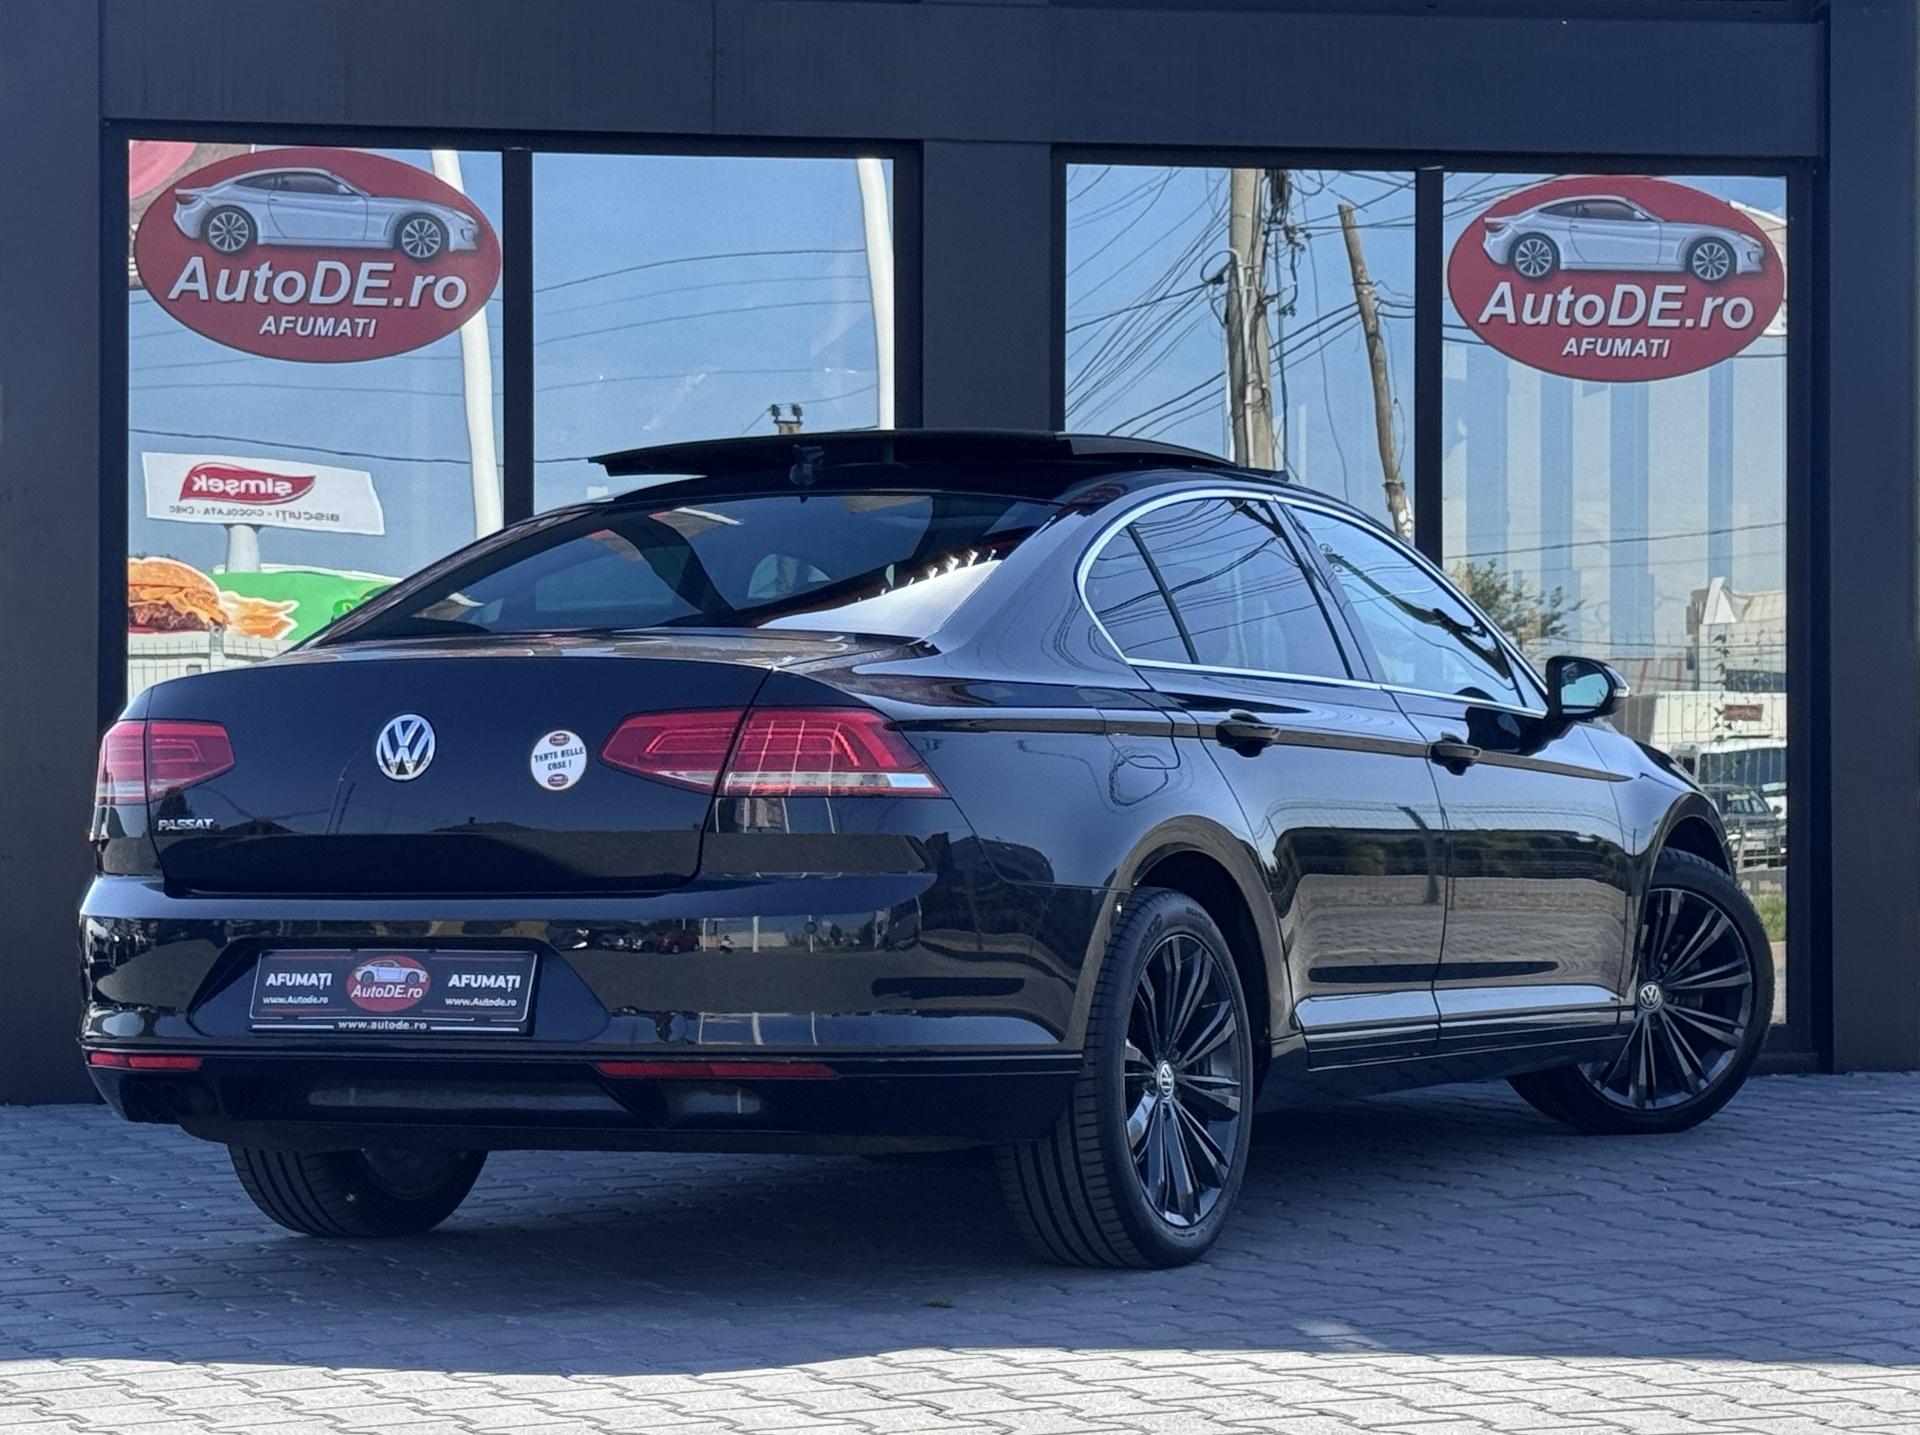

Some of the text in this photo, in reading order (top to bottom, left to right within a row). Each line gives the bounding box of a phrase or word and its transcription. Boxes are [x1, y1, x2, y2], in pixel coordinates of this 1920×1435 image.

[168, 255, 468, 310] AutoDE.ro
[1478, 281, 1754, 329] AutoDE.ro
[259, 315, 378, 338] AFUMATI
[1561, 336, 1671, 359] AFUMATI
[158, 818, 214, 831] PASSAT
[351, 984, 423, 998] AutoDE.ro
[338, 1020, 428, 1030] www.autode.ro
